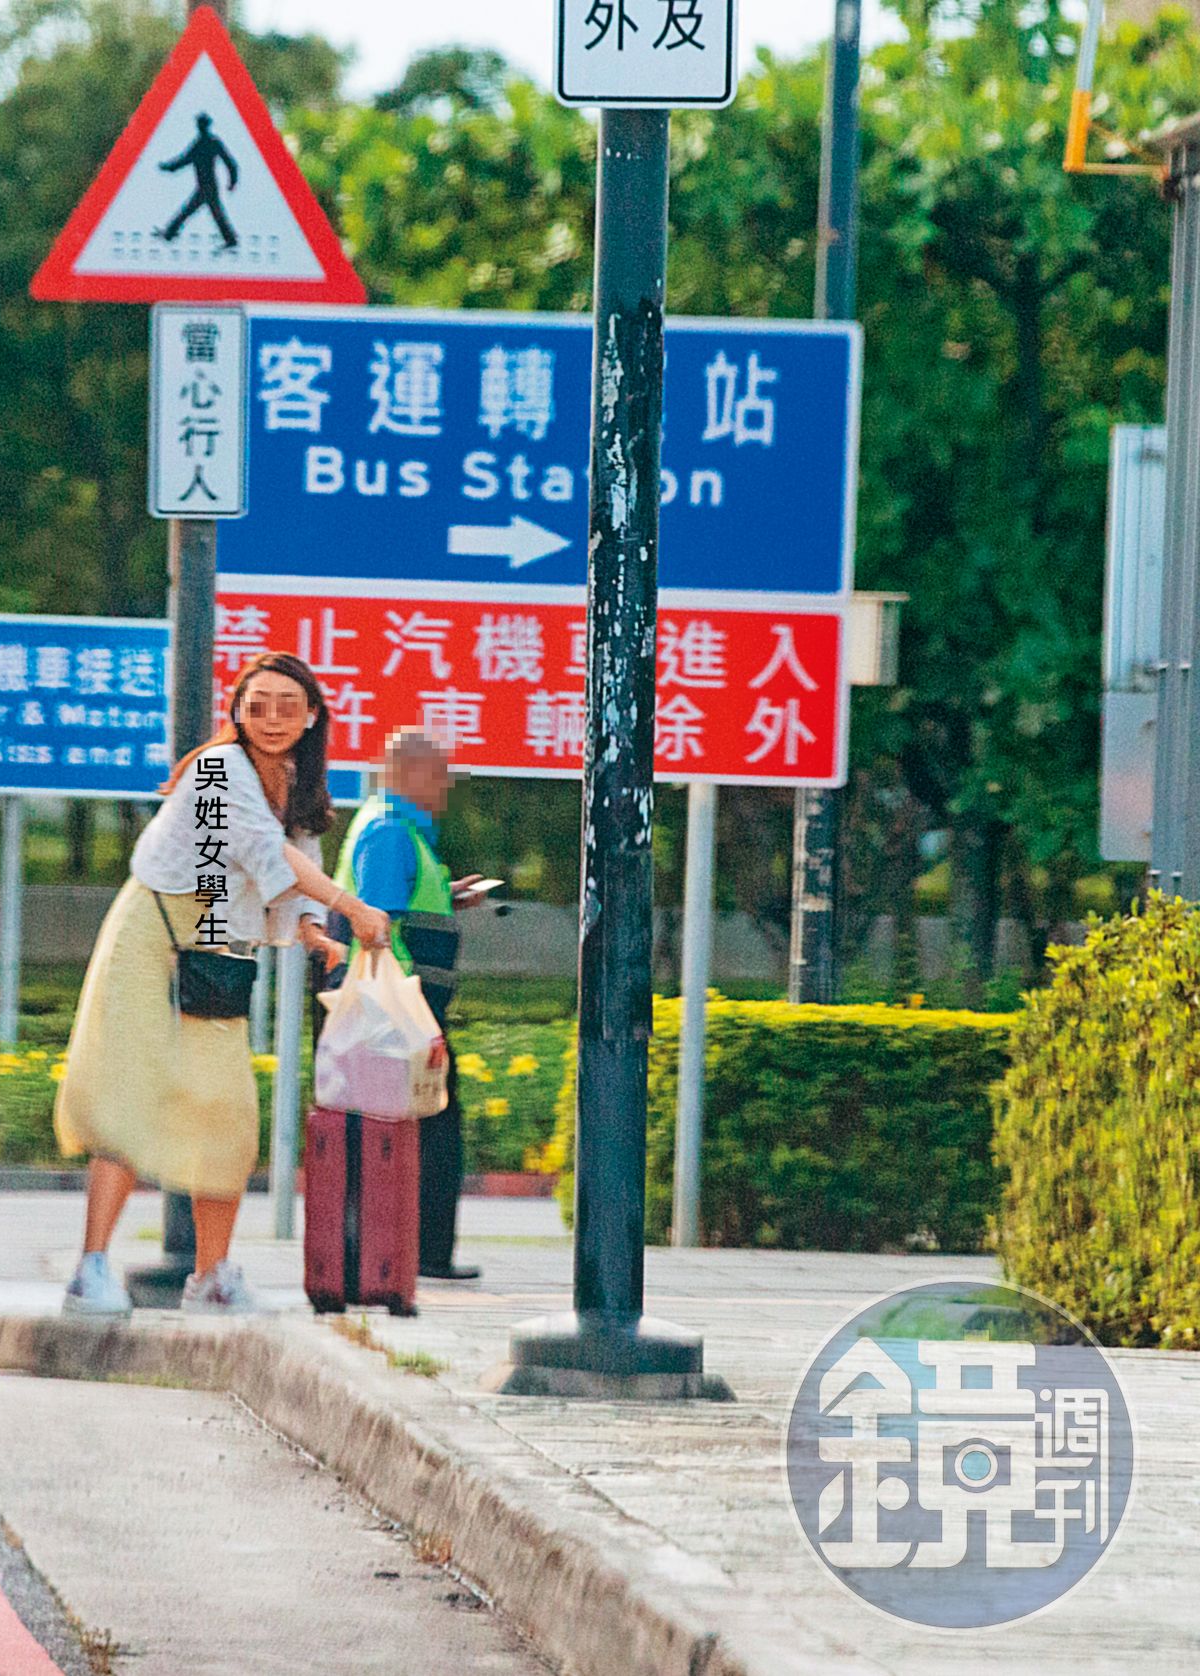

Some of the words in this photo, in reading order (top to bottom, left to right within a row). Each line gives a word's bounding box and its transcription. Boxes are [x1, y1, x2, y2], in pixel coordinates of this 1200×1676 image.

[178, 322, 222, 503] 當心行人
[257, 337, 779, 447] 客運轉站
[305, 446, 432, 497] Bus
[462, 451, 724, 506] Staon
[214, 603, 818, 692] 禁止汽機進入
[58, 703, 167, 728] Motor
[213, 677, 818, 766] 許車輛除外
